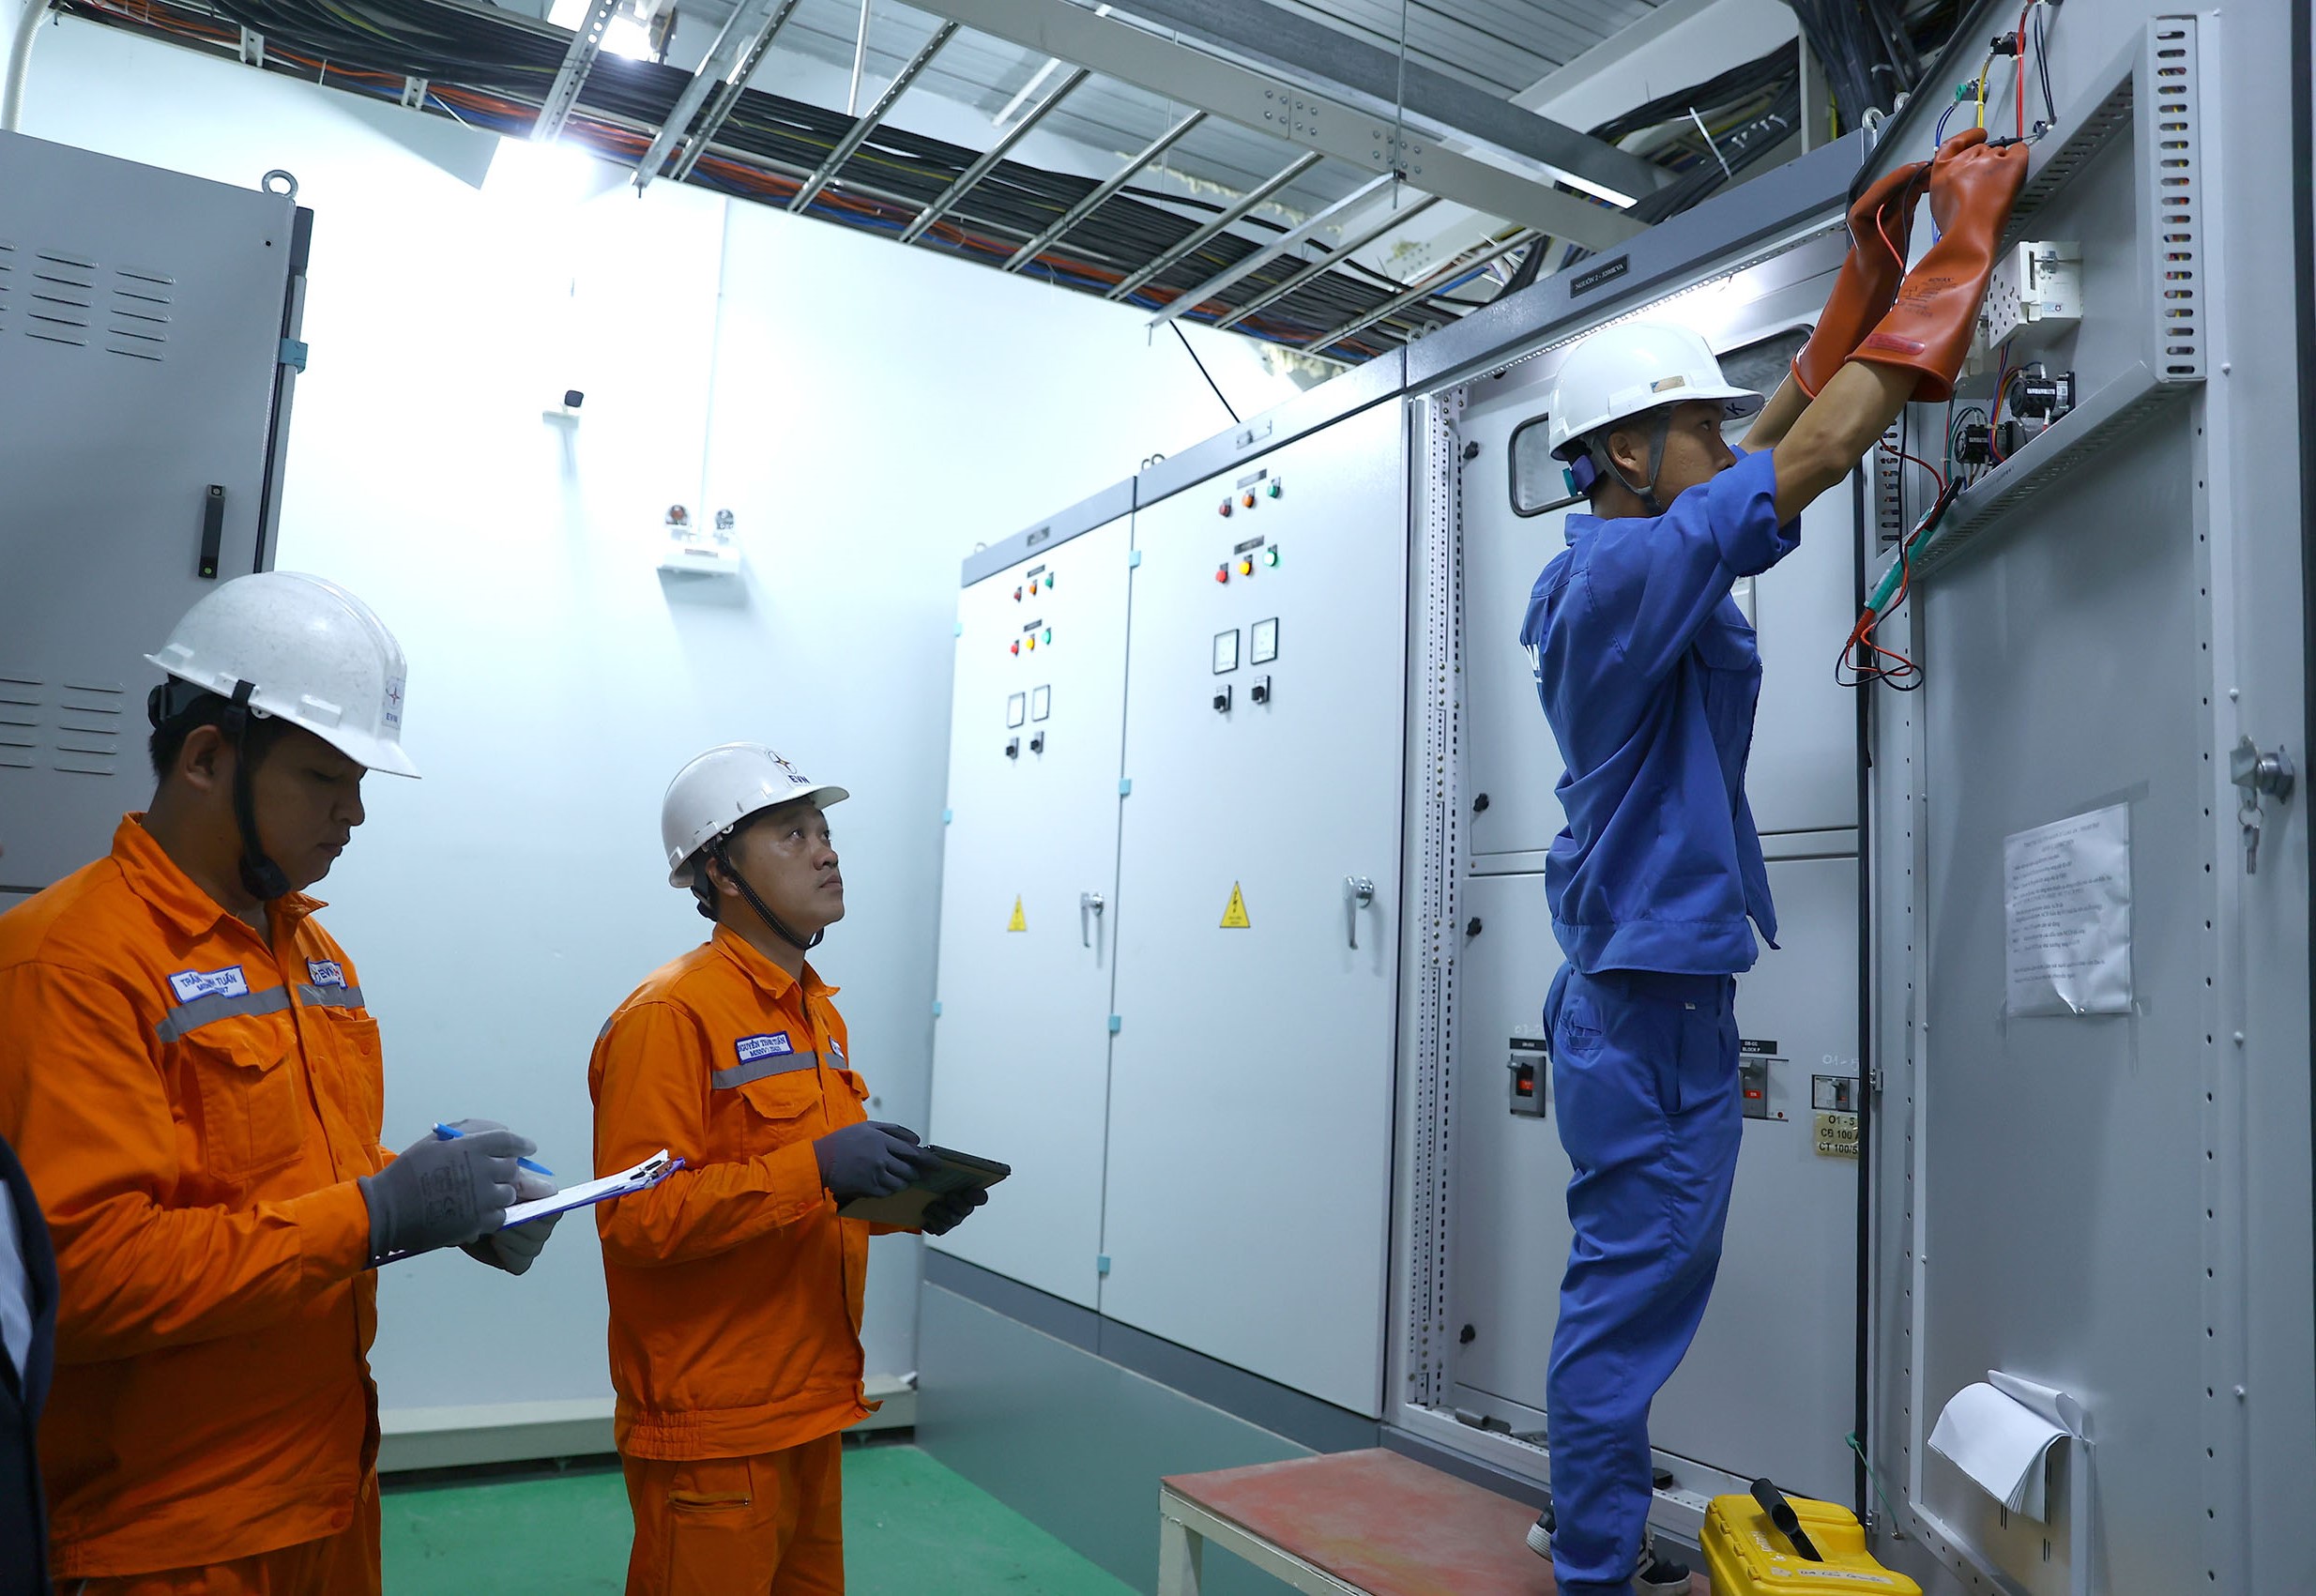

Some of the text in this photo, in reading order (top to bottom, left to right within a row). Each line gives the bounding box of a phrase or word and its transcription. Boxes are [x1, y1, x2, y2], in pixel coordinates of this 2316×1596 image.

[788, 775, 811, 783] EVN
[1821, 1128, 1834, 1137] CB
[1837, 1131, 1852, 1139] 100
